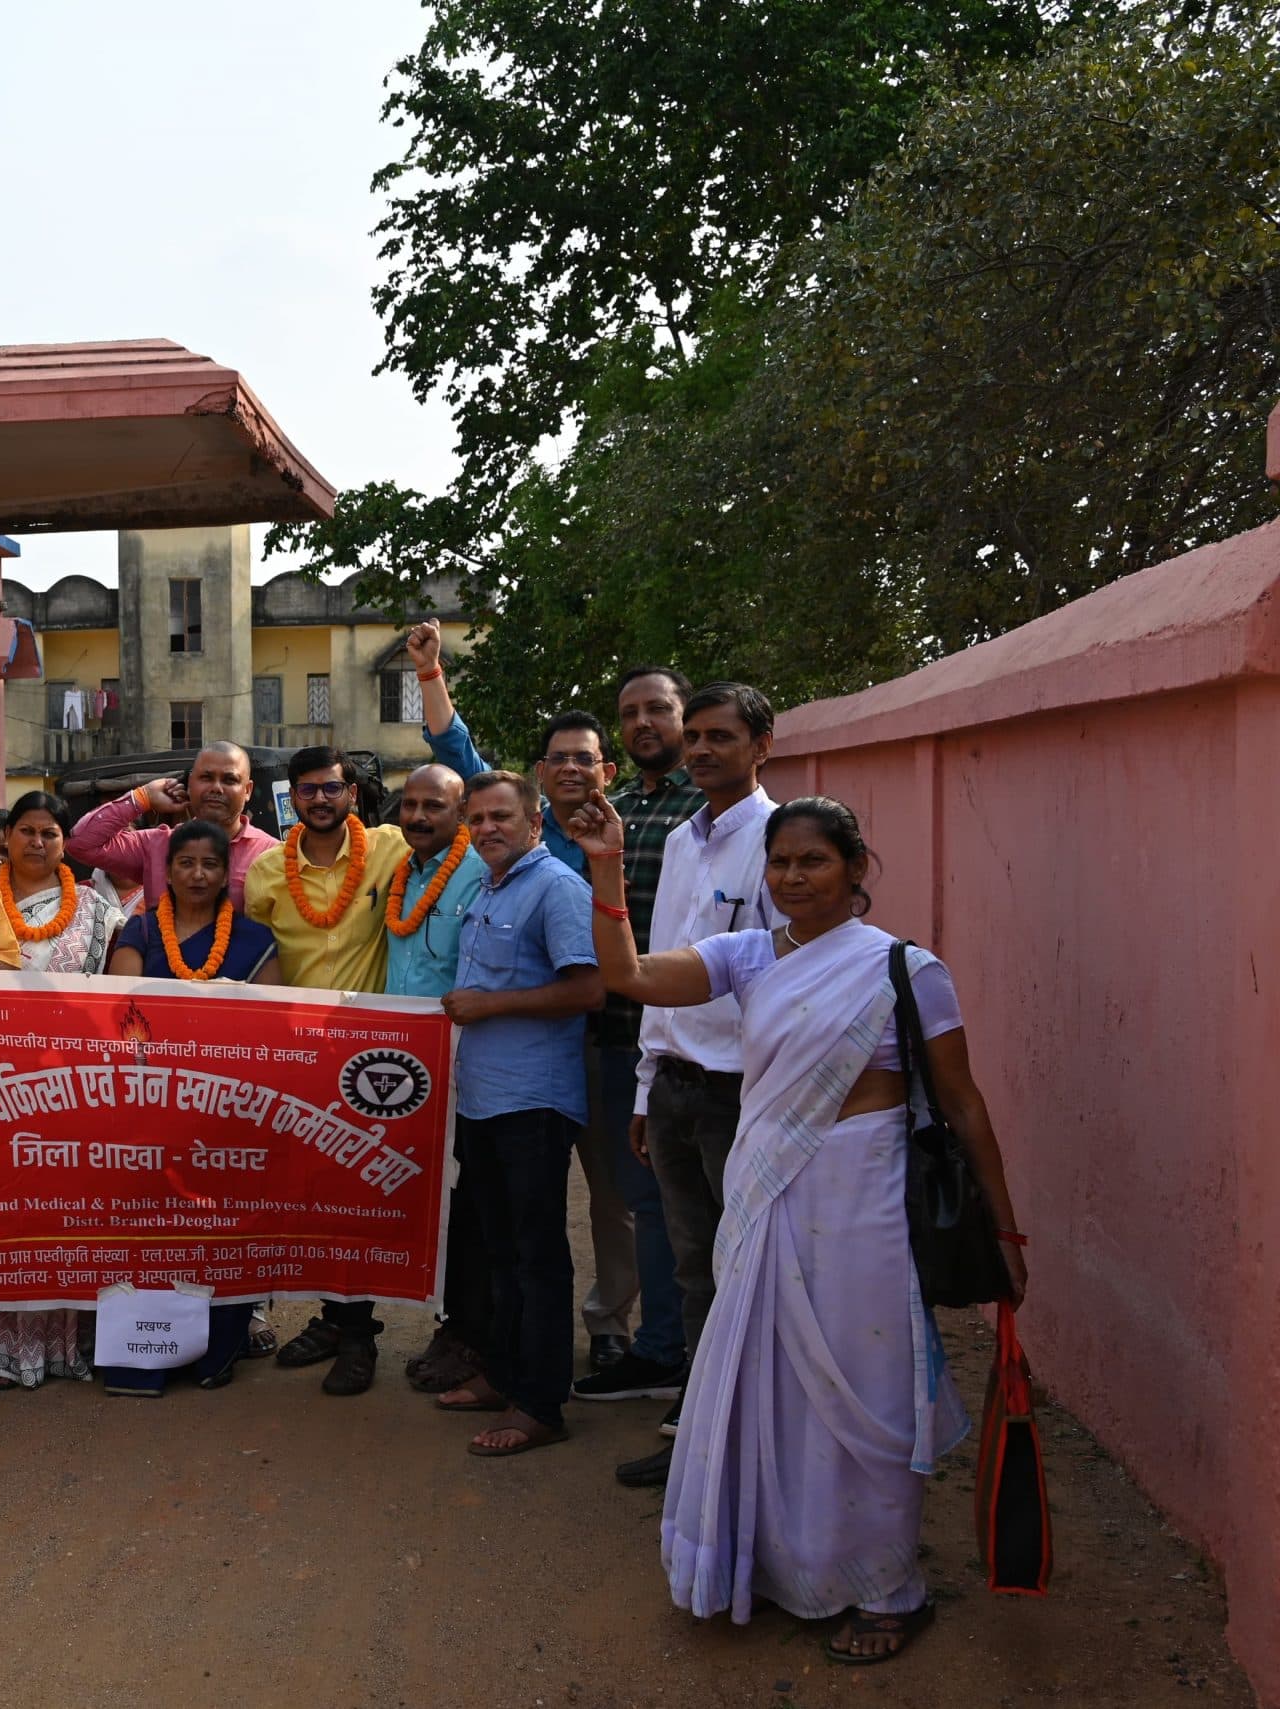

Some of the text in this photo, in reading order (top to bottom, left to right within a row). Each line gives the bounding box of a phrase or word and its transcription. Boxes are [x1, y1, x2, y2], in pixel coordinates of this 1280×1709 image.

[306, 1026, 325, 1038] जय
[50, 1037, 82, 1052] राज्य
[86, 1037, 140, 1055] सरकारी
[142, 1039, 197, 1057] कर्मचारी
[200, 1042, 251, 1061] महासंघ
[254, 1043, 270, 1061] से
[272, 1049, 318, 1065] सम्बद्ध
[75, 1052, 116, 1108] एवं
[118, 1065, 172, 1108] जन
[175, 1068, 278, 1128] स्वास्थ्य
[271, 1092, 388, 1169] कर्मचारी
[359, 1145, 424, 1196] संघ
[9, 1132, 80, 1169] जिला
[87, 1143, 165, 1171] शाखा
[188, 1139, 268, 1171] देवघर
[24, 1197, 86, 1211] Medical
[91, 1198, 105, 1210] &
[111, 1197, 160, 1211] Public
[165, 1197, 217, 1210] Health
[223, 1197, 306, 1213] Employees
[63, 1214, 240, 1230] Distt. Branch-Deoghar
[8, 1250, 32, 1265] प्राप्त
[91, 1246, 130, 1263] संख्या
[212, 1247, 243, 1261] 3021
[247, 1243, 287, 1259] दिनांक
[289, 1245, 360, 1261] 01.06.1944
[364, 1246, 410, 1267] (बिहार)
[56, 1270, 98, 1287] पुराना
[101, 1270, 134, 1284] सदर
[203, 1264, 243, 1282] देवघर
[257, 1264, 303, 1279] 814112
[136, 1321, 172, 1332] प्रखण्ड
[127, 1340, 179, 1355] पालोजोरी
